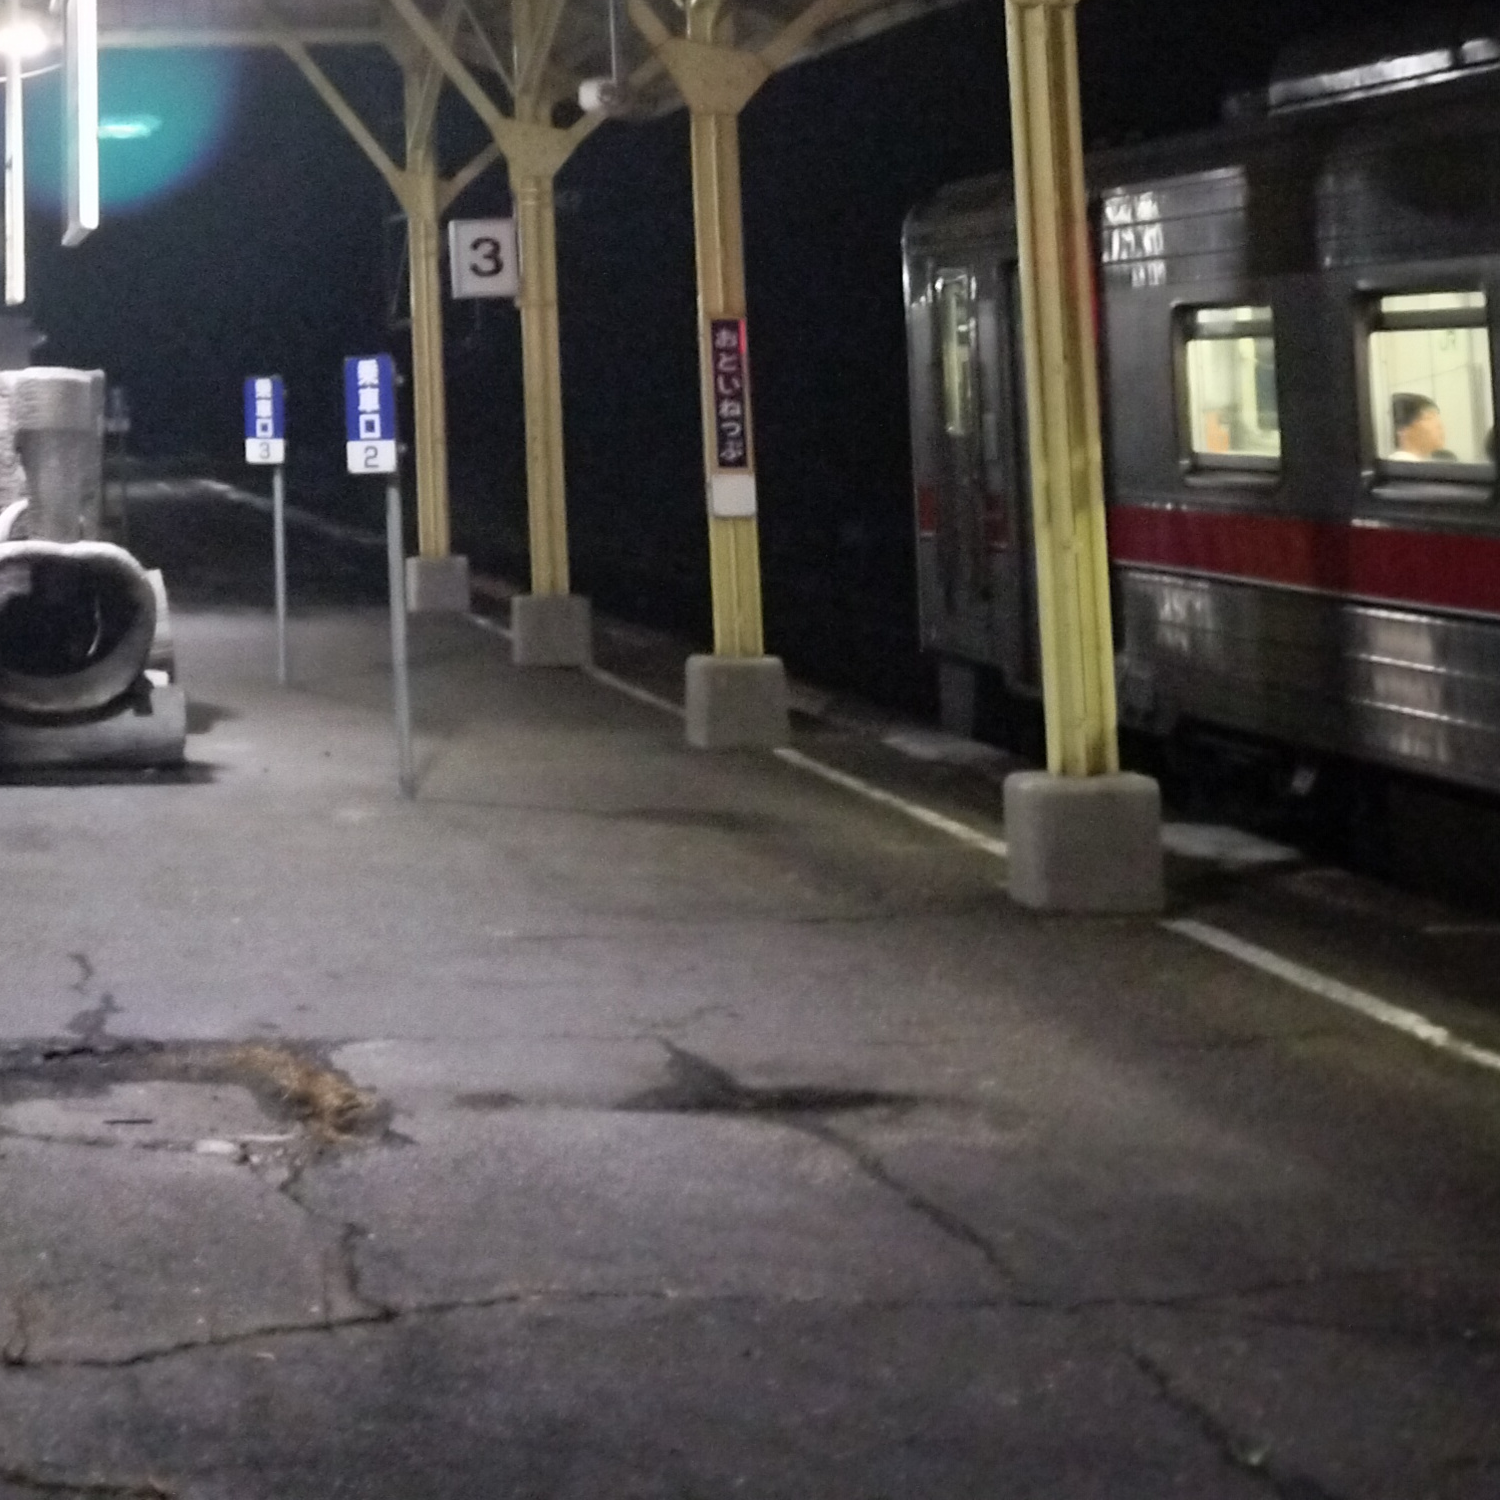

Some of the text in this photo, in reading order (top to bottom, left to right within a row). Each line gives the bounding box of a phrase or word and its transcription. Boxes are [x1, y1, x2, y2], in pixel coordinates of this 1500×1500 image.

[469, 237, 505, 279] 3
[258, 441, 272, 460] 3
[363, 445, 380, 469] 2
